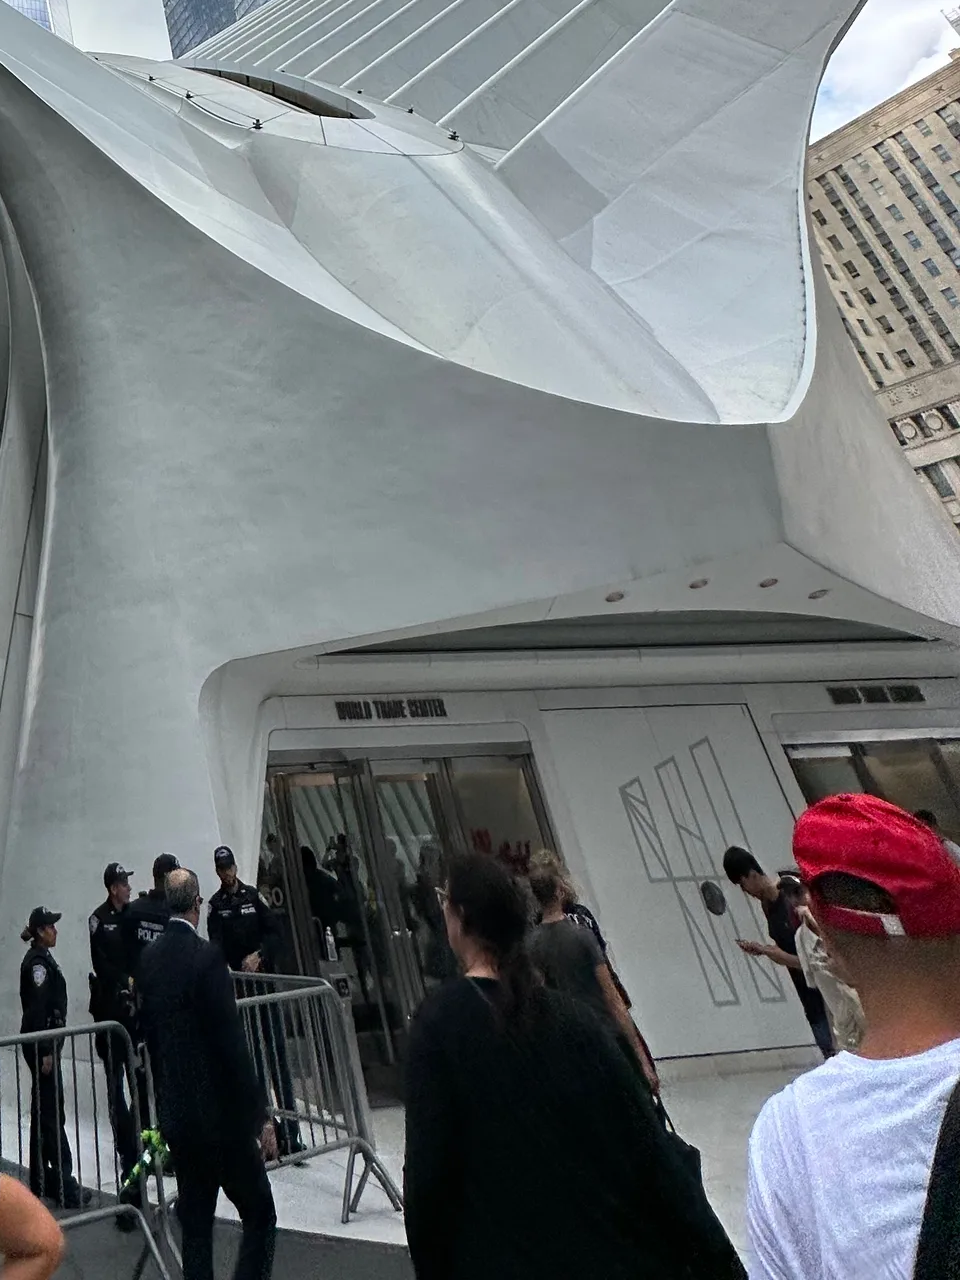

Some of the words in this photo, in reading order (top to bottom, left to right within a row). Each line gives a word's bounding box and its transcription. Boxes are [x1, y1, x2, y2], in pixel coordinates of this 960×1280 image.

[372, 700, 407, 719] TRADE
[406, 698, 447, 718] CENTER
[138, 928, 164, 941] POLI
